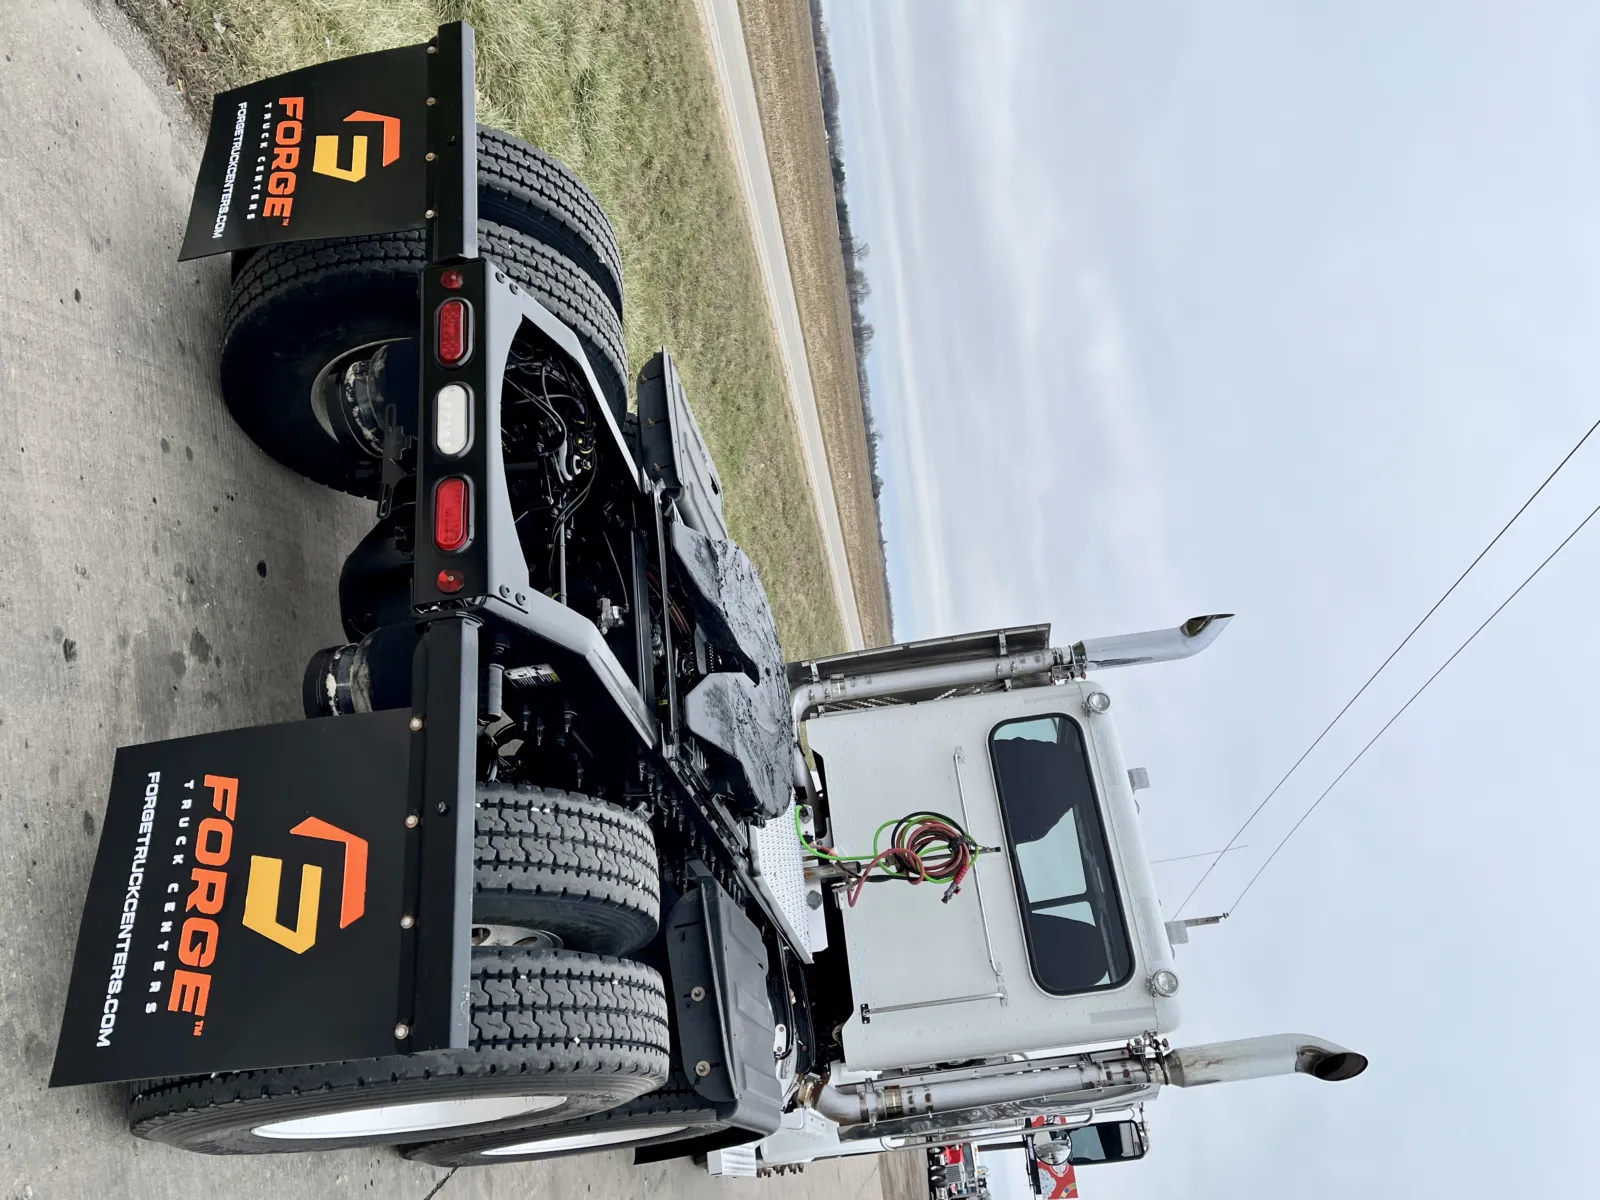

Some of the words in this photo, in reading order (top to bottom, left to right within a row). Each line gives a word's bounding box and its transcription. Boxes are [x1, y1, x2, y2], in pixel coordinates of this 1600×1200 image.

[212, 101, 248, 239] FORGETRUCKCENTERS.COM
[246, 155, 266, 220] CENTERS
[259, 102, 272, 149] TRUCK
[263, 97, 304, 218] FORGE
[172, 780, 195, 866] TRUCK
[96, 771, 161, 1048] FORGETRUCKCENTERS.COM
[145, 882, 179, 1014] CENTERS
[168, 774, 239, 1017] FORGE
